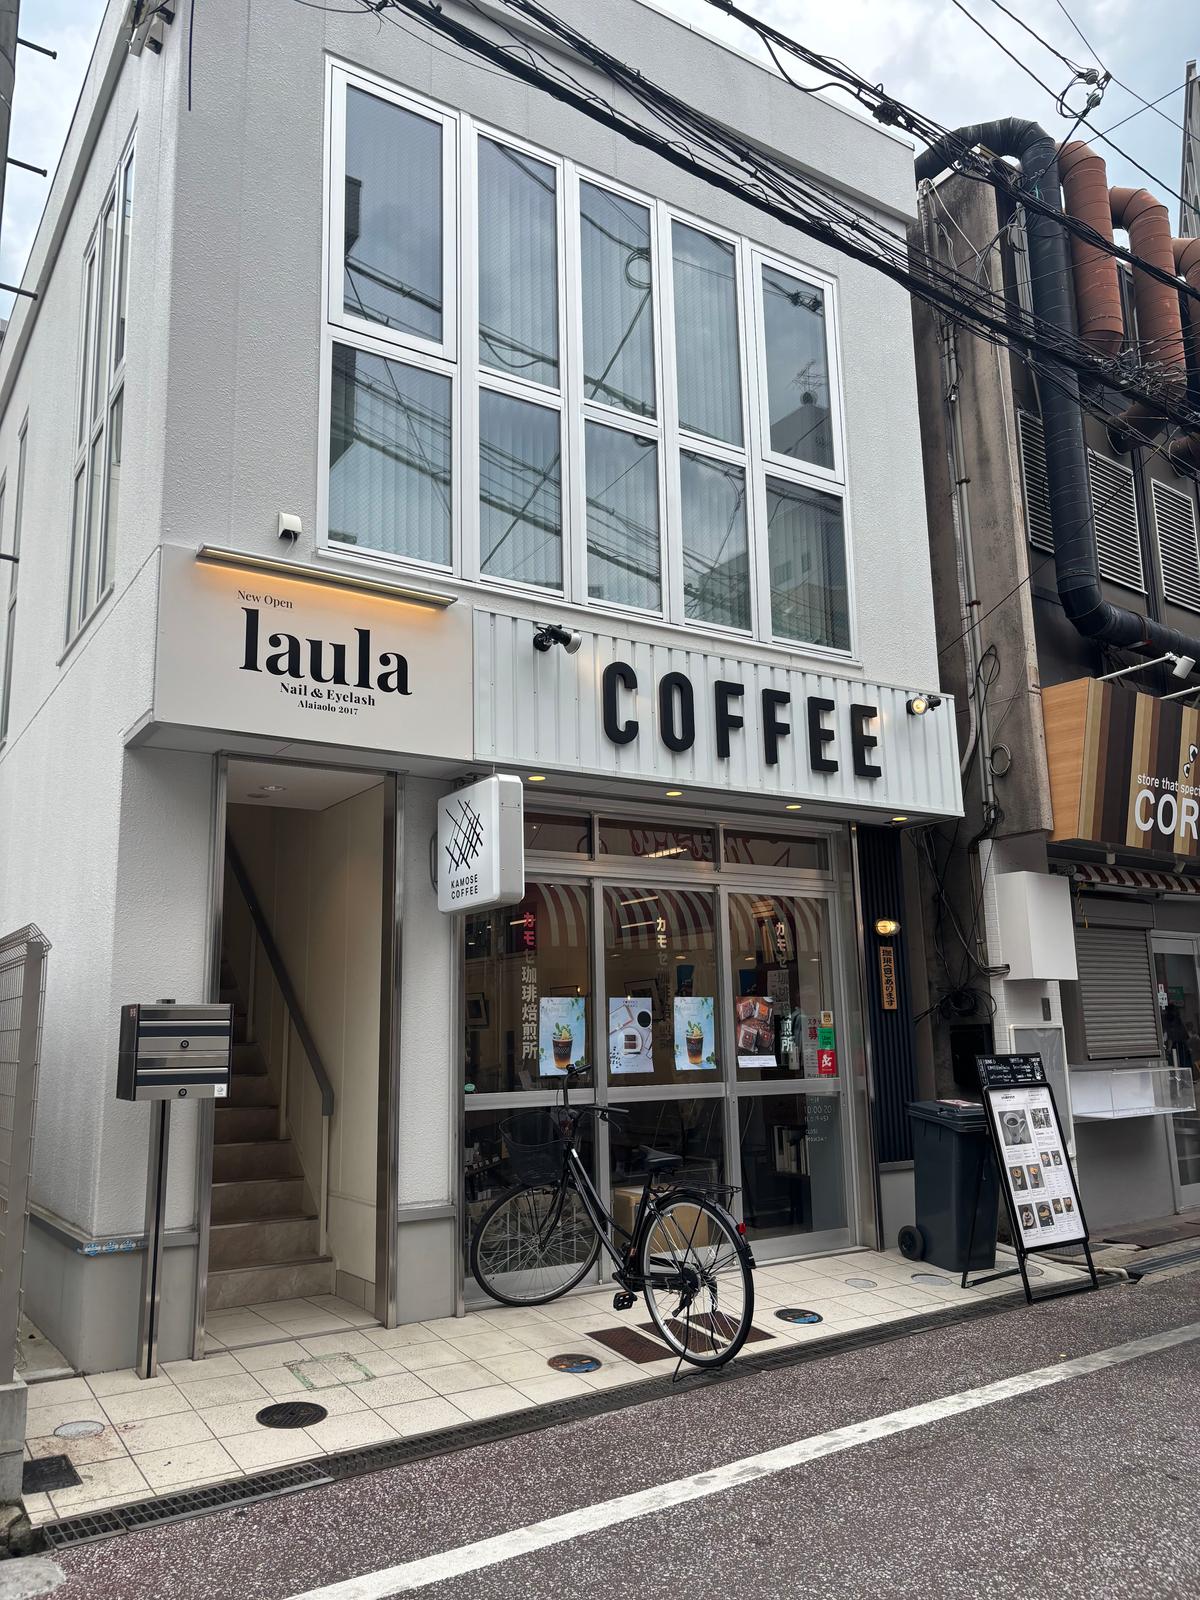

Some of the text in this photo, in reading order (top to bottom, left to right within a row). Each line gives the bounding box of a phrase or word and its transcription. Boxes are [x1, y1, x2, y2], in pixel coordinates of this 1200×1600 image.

[237, 590, 293, 609] New Open
[239, 606, 413, 696] laula
[280, 682, 375, 706] Nail & Eyelash
[338, 706, 358, 716] 2017
[602, 661, 882, 778] COFFEE
[1137, 773, 1159, 787] store
[1162, 777, 1179, 792] that
[1135, 789, 1200, 840] COR
[450, 873, 478, 889] KAMOSE
[450, 885, 478, 900] COFFEE
[521, 912, 538, 1060] カモセ珈琲焙煎所
